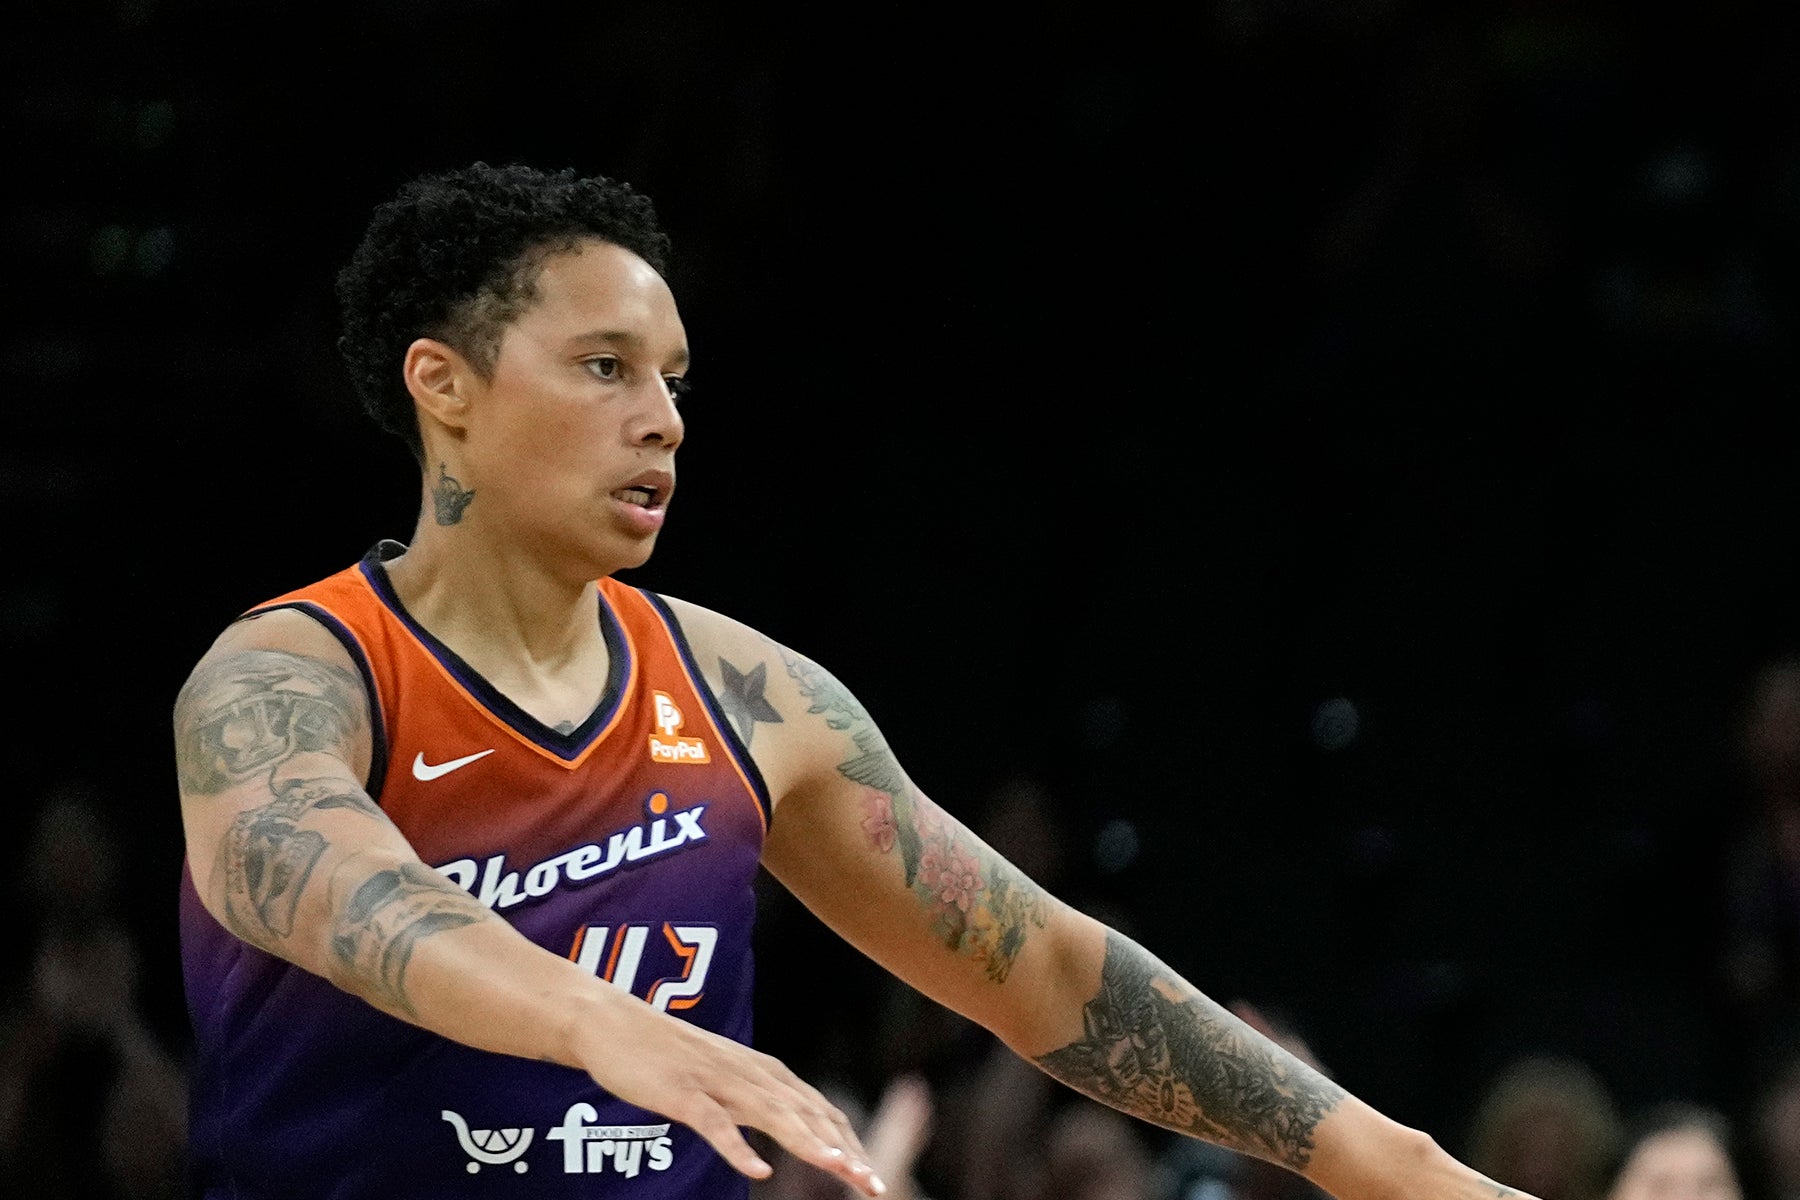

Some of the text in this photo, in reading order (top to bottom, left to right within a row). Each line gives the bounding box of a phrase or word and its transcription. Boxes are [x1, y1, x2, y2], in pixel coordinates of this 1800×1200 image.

[650, 738, 706, 760] PayPal
[434, 793, 707, 908] Phoenix
[545, 1102, 673, 1179] fry's
